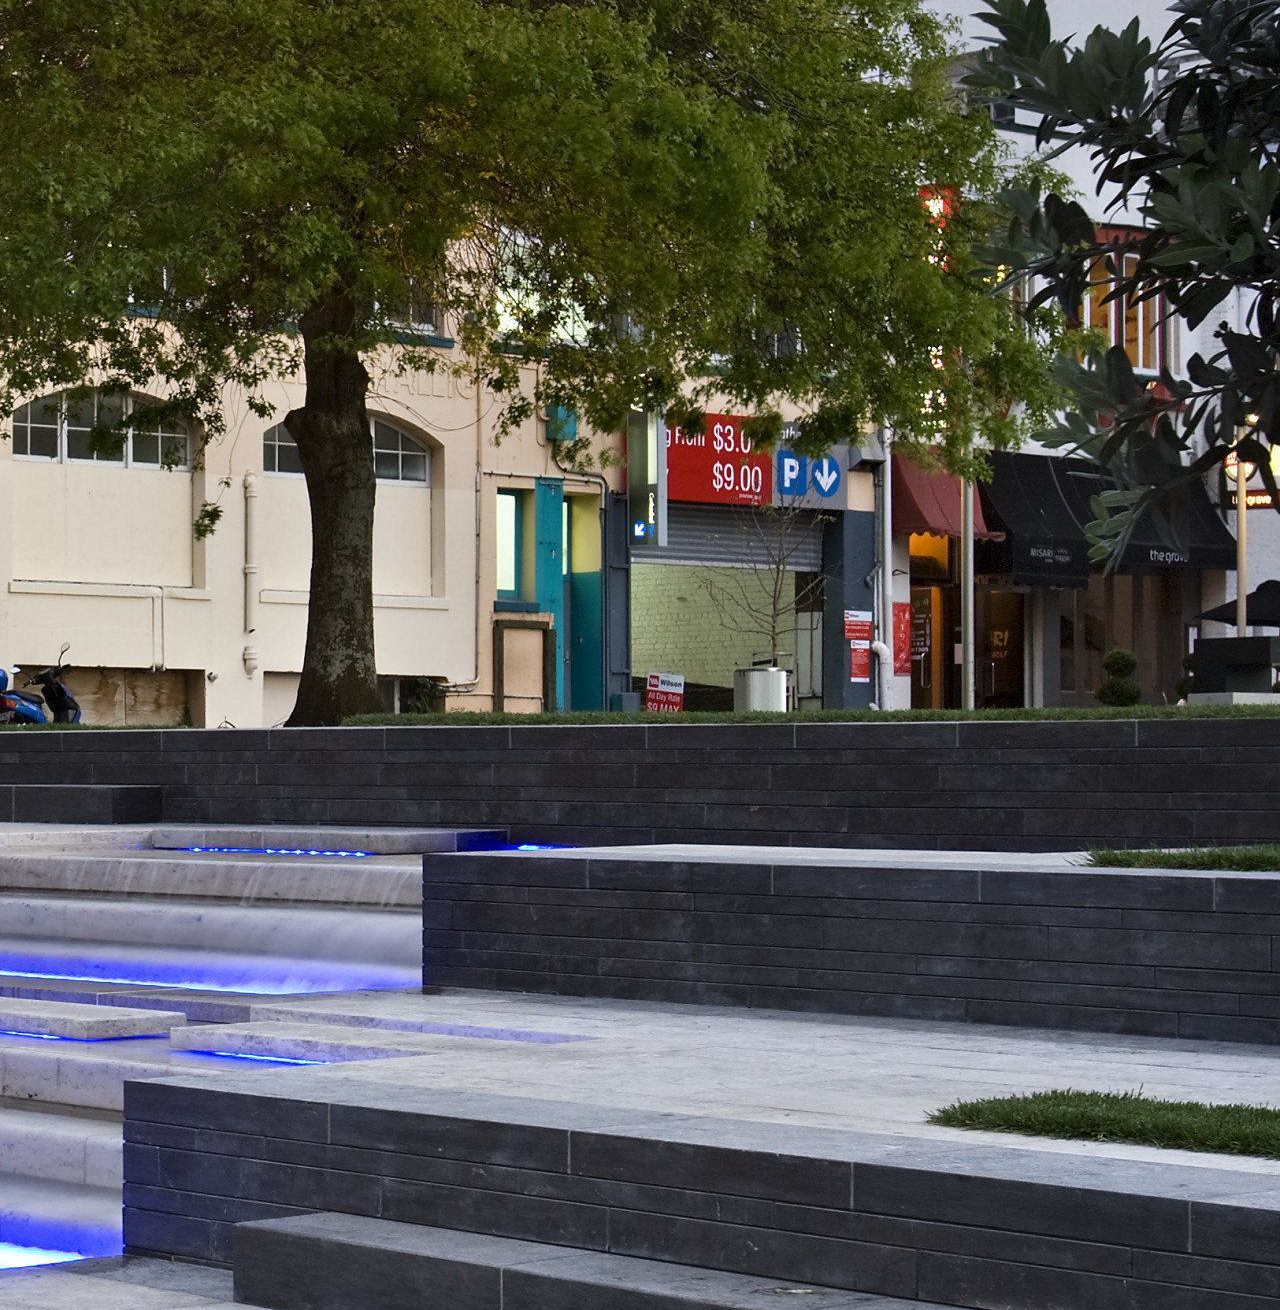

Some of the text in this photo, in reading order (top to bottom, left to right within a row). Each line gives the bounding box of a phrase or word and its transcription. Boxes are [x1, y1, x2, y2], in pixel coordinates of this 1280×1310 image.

[712, 461, 762, 493] $9.00
[784, 458, 799, 487] P
[660, 679, 682, 687] Wilson
